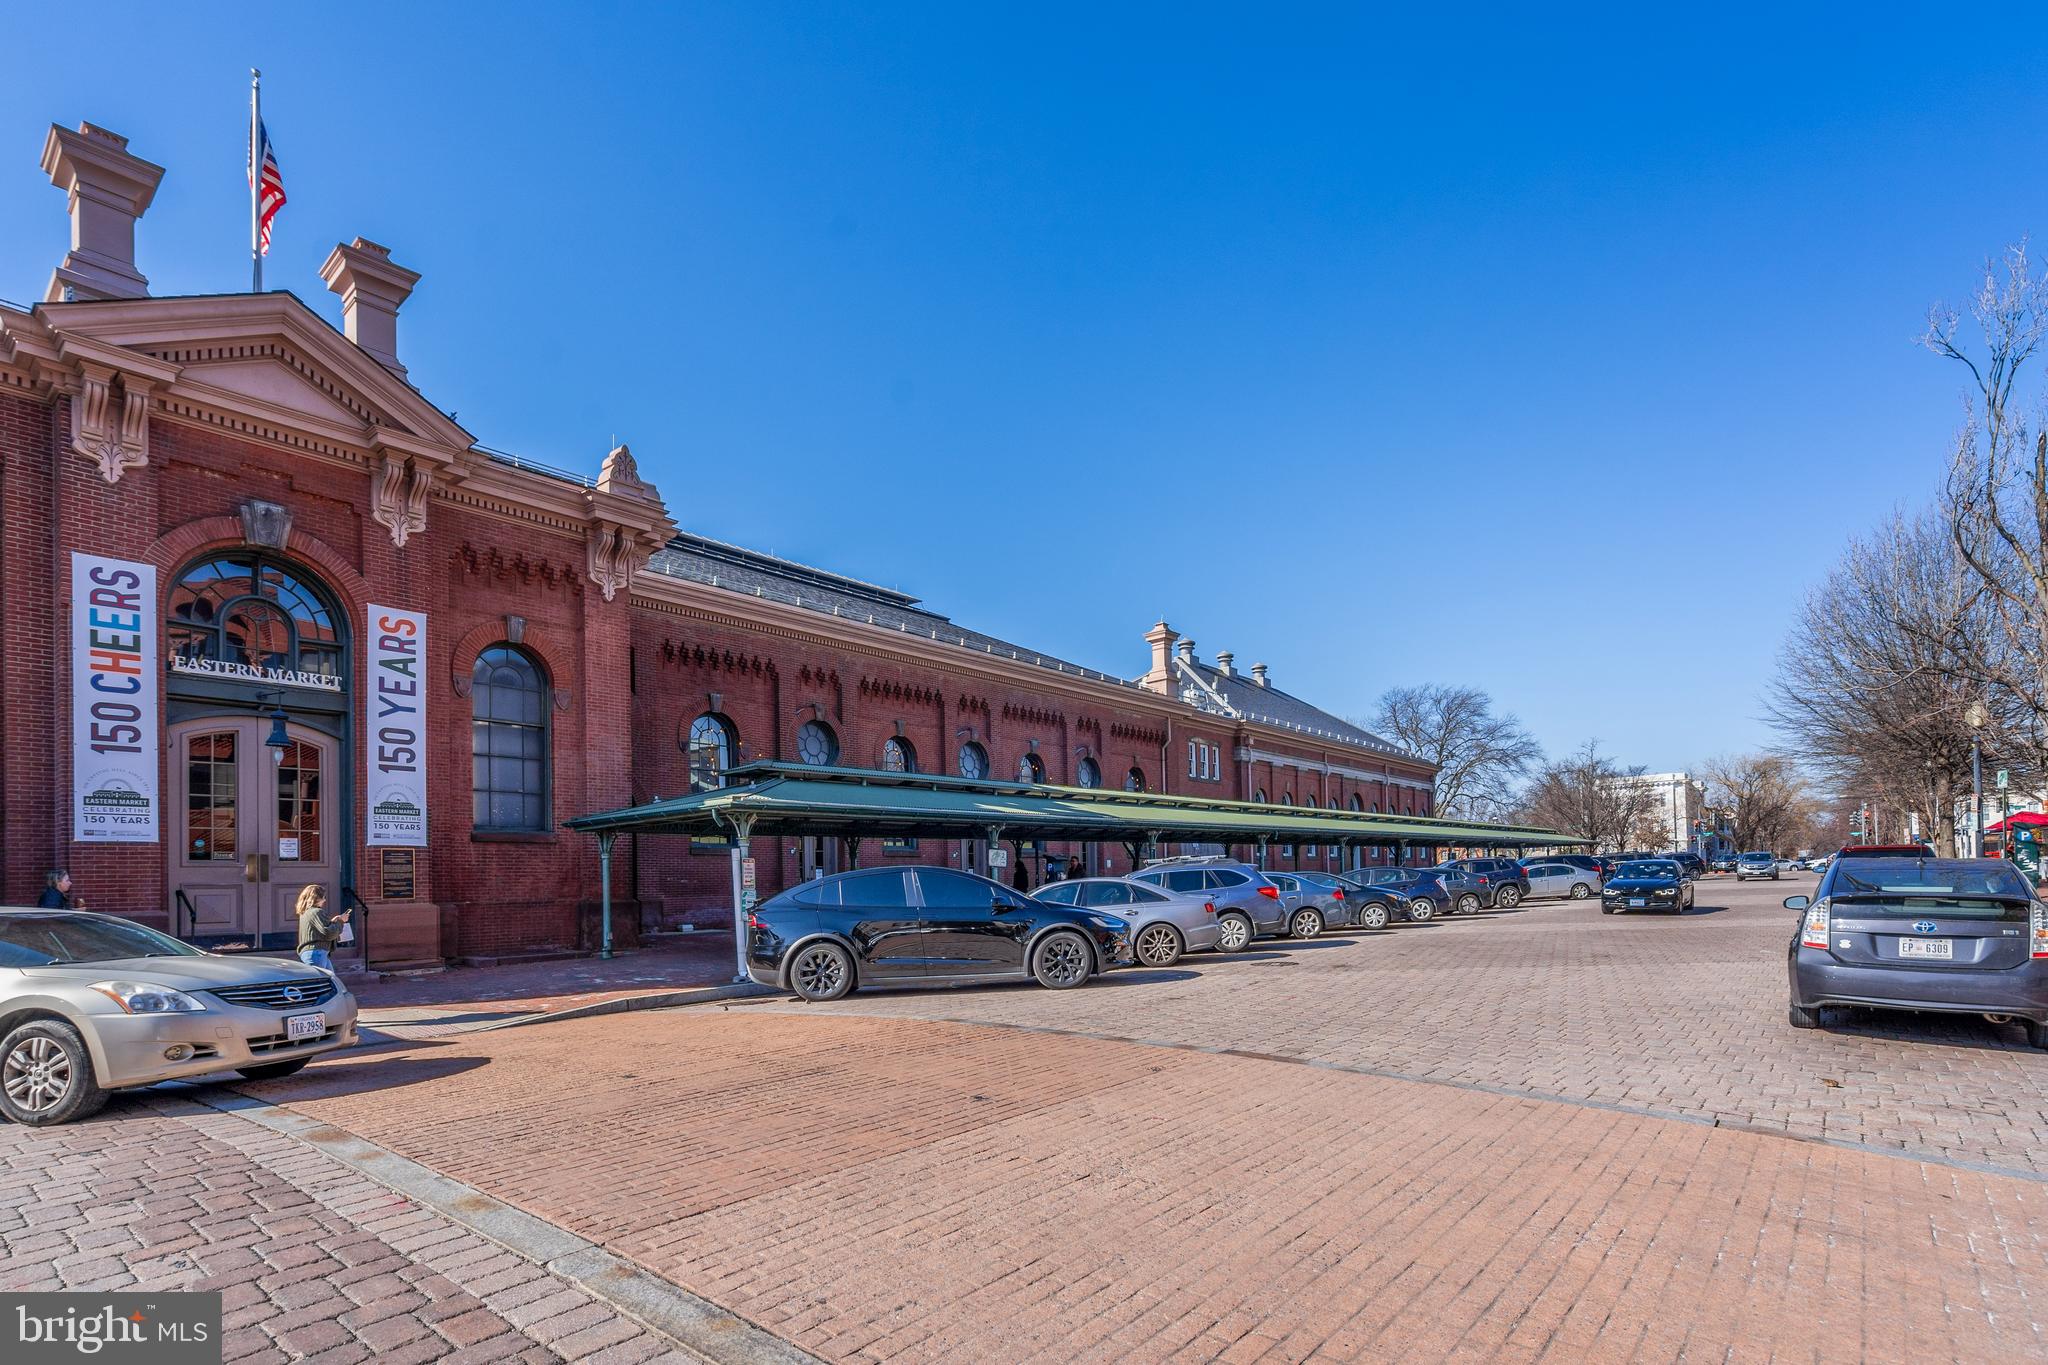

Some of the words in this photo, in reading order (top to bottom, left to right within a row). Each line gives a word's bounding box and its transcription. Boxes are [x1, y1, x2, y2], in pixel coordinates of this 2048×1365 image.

[89, 566, 141, 695] CHEERS
[173, 655, 264, 678] EASTERN
[267, 666, 342, 688] MARKET
[378, 616, 416, 718] YEARS
[90, 702, 142, 755] 150
[378, 727, 416, 774] 150
[112, 816, 151, 824] YEARS
[393, 823, 421, 831] YEARS
[2021, 831, 2029, 840] P
[1902, 942, 1914, 953] EP
[1925, 943, 1948, 954] 6309
[291, 1020, 324, 1035] TKR-2958
